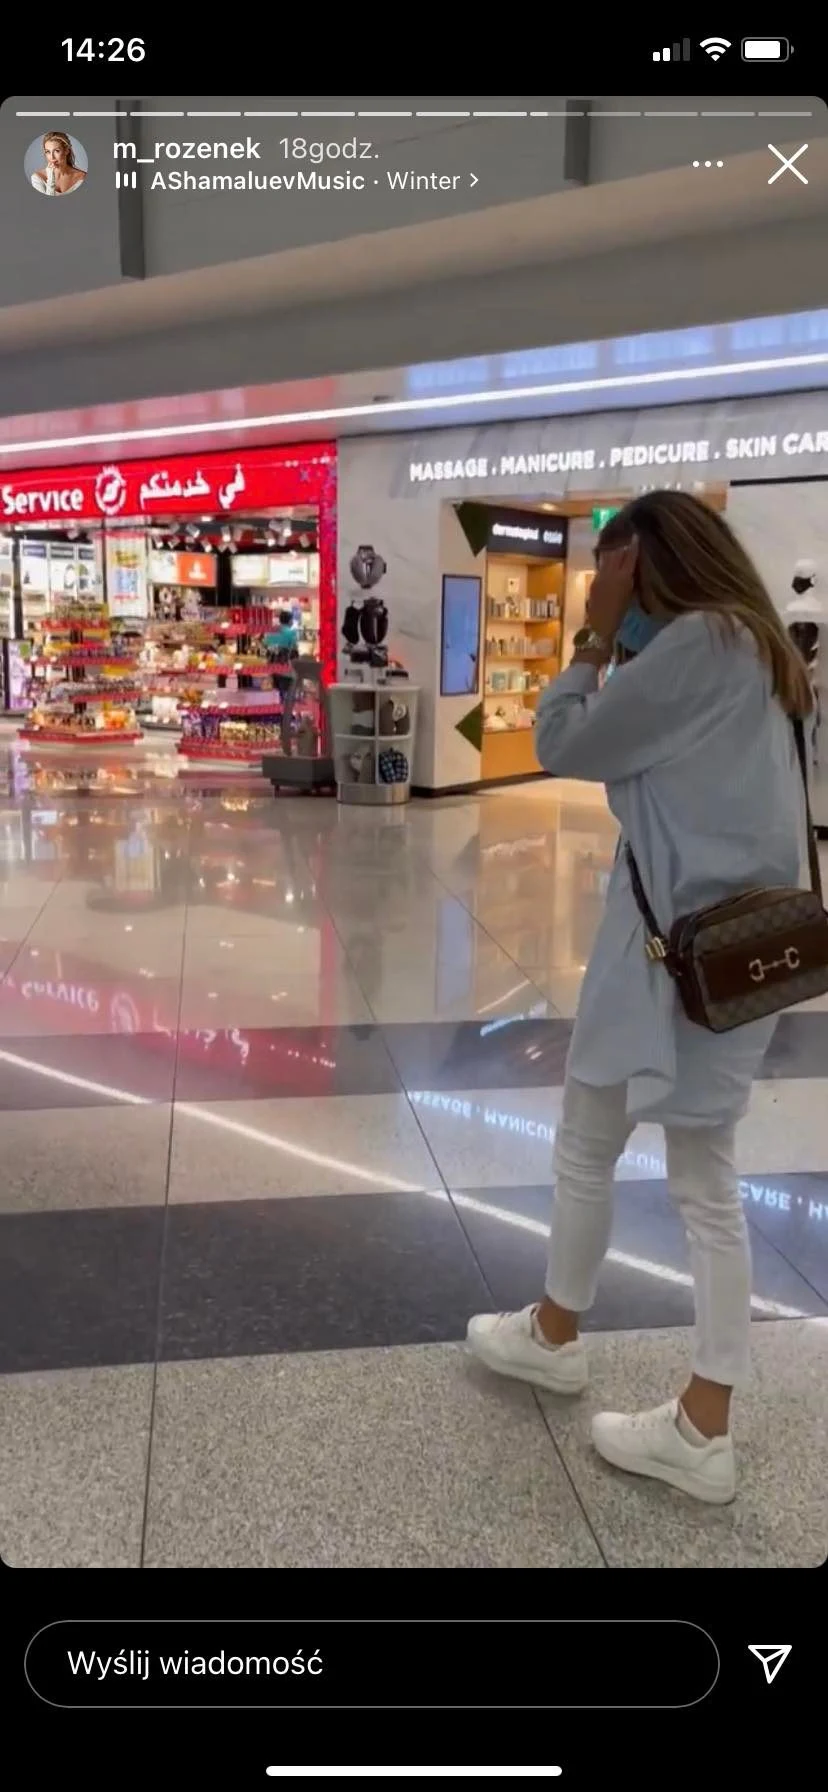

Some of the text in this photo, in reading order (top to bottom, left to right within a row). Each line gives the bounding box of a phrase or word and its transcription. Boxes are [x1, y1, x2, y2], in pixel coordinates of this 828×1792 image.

[410, 458, 488, 481] MASSAGE
[501, 450, 595, 475] MANICURE
[610, 440, 709, 467] PEDICURE
[726, 435, 777, 458] SKIN
[1, 484, 84, 515] Service
[140, 464, 245, 511] في خدمتكم
